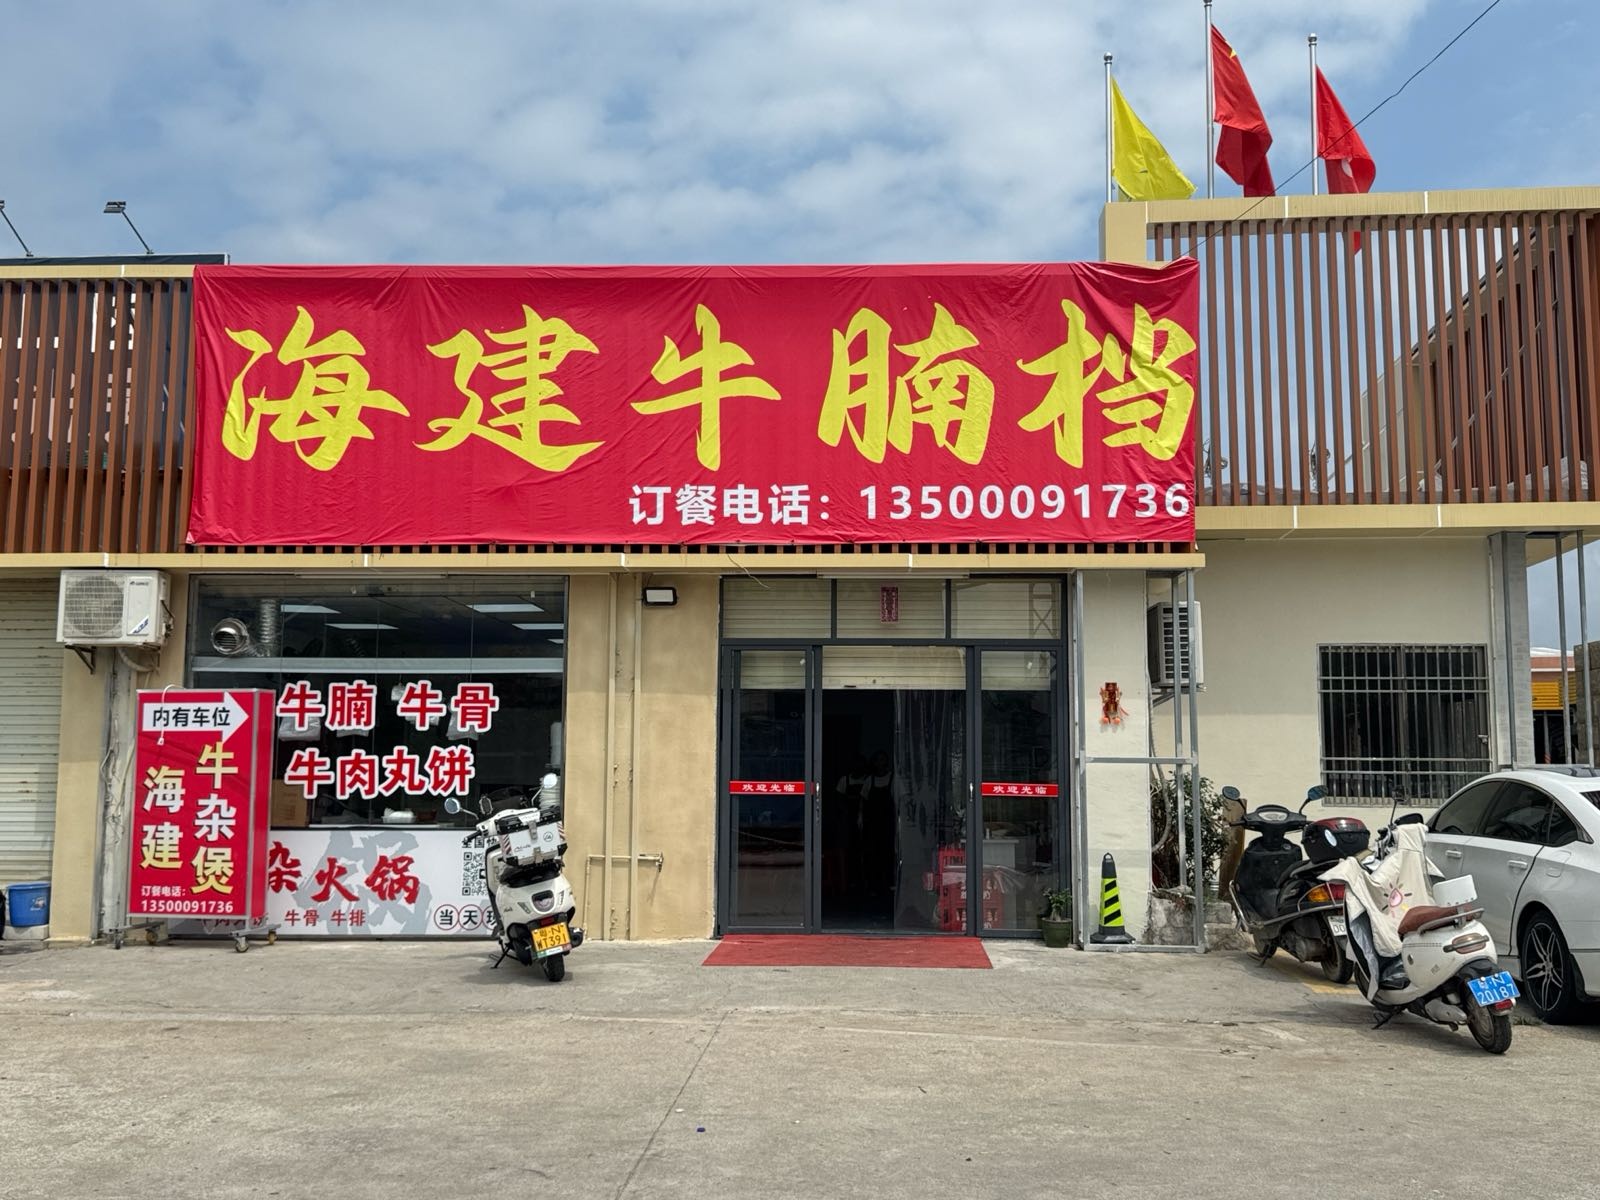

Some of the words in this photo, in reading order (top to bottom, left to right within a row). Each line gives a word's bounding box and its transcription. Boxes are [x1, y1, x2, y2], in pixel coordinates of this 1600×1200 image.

[222, 298, 1196, 472] 海建牛腩档
[277, 680, 377, 731] 牛腩
[397, 680, 499, 732] 牛骨
[153, 707, 231, 727] 内有车位
[284, 744, 475, 799] 牛肉丸饼
[742, 783, 796, 792] 欢迎光临
[992, 785, 1048, 795] 欢迎光临
[140, 765, 186, 869] 海建
[190, 741, 239, 894] 牛杂煲
[141, 900, 234, 913] 13500091736
[284, 909, 320, 926] 牛骨
[330, 909, 366, 926] 牛排
[1477, 983, 1516, 1004] 20187
